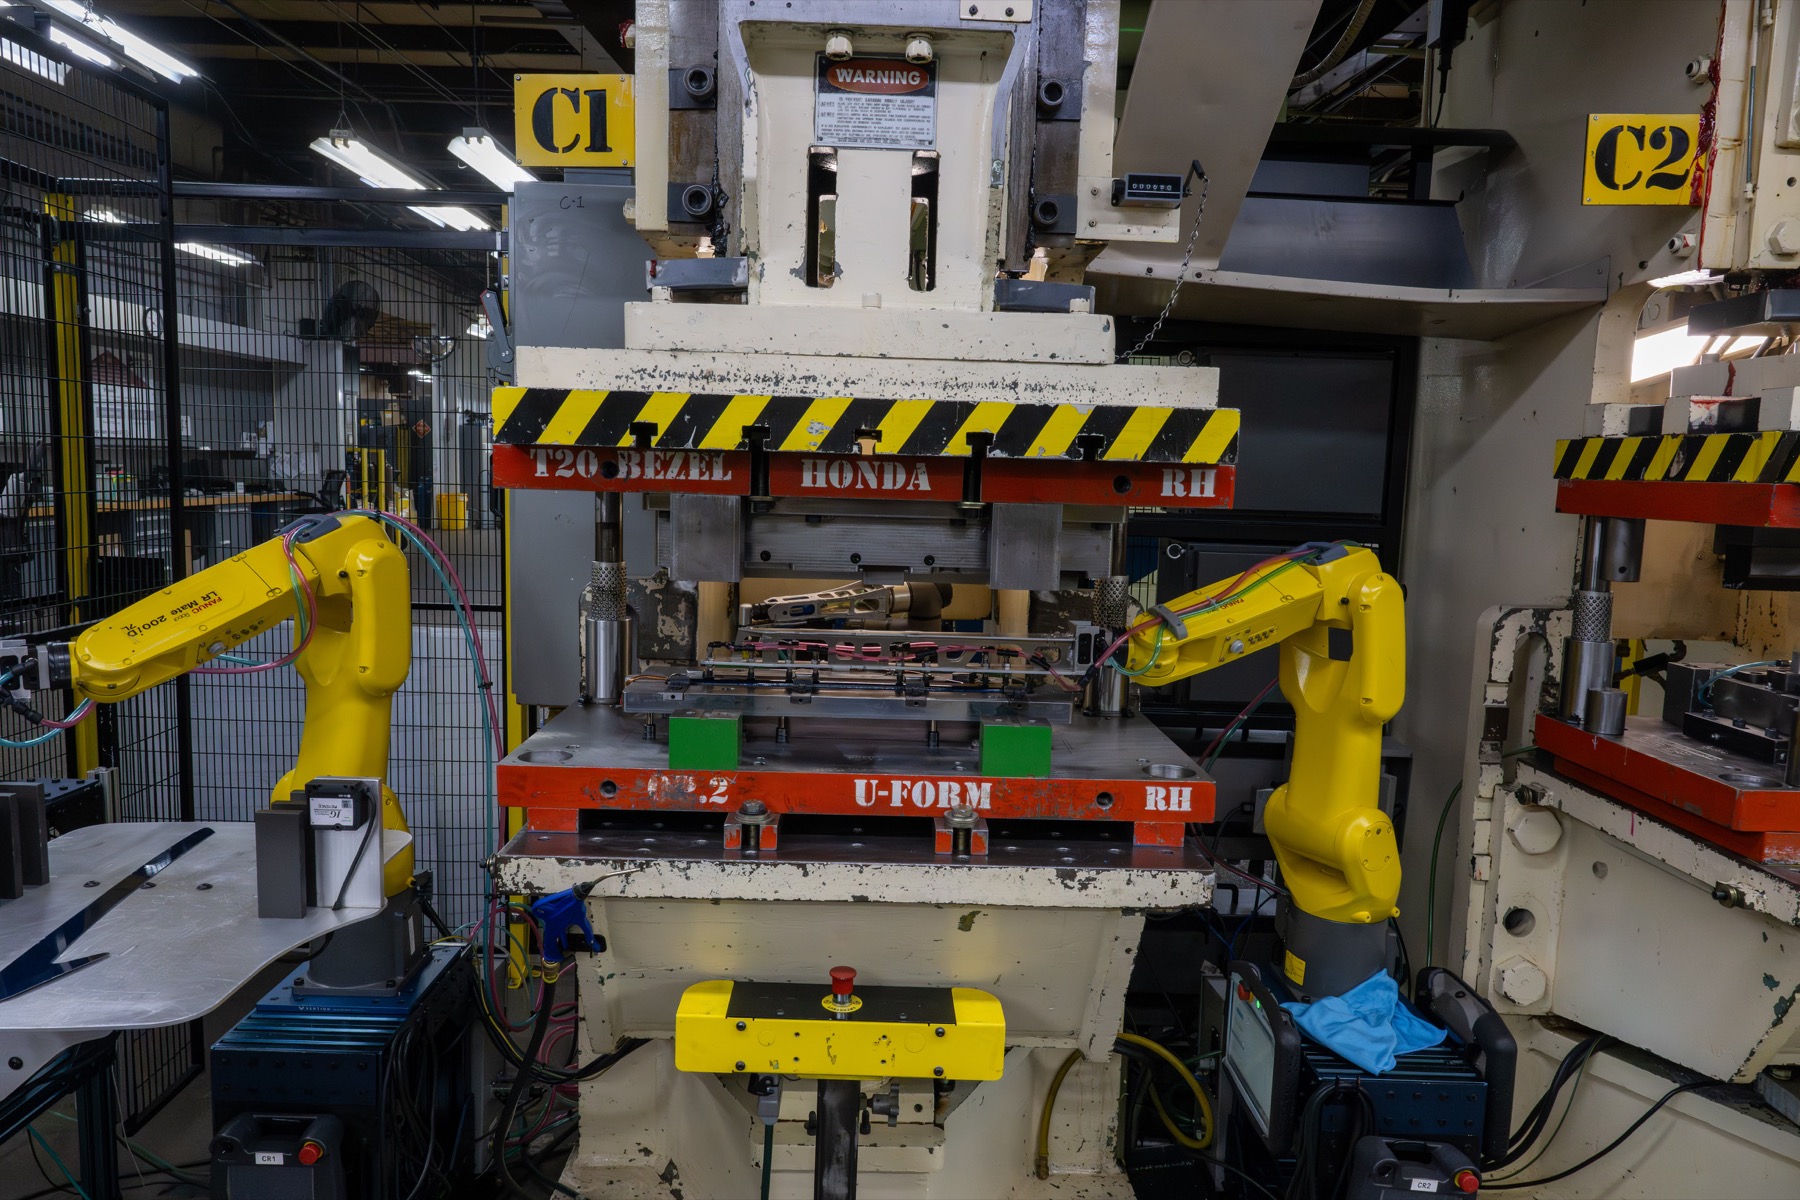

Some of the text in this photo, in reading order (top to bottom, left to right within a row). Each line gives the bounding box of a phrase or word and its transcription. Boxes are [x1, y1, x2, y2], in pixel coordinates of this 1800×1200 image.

[836, 68, 921, 85] WARNING
[532, 87, 613, 154] C1
[1595, 125, 1690, 191] C2
[559, 196, 585, 210] C-1
[530, 449, 1217, 498] T20 BEZEL HONDA RH
[201, 590, 218, 602] LR
[1221, 598, 1244, 609] FANUC
[171, 600, 199, 615] Mate
[192, 597, 223, 614] FANUC
[854, 779, 993, 809] U-FORM
[1144, 786, 1193, 812] RH
[1417, 1181, 1432, 1190] CR2
